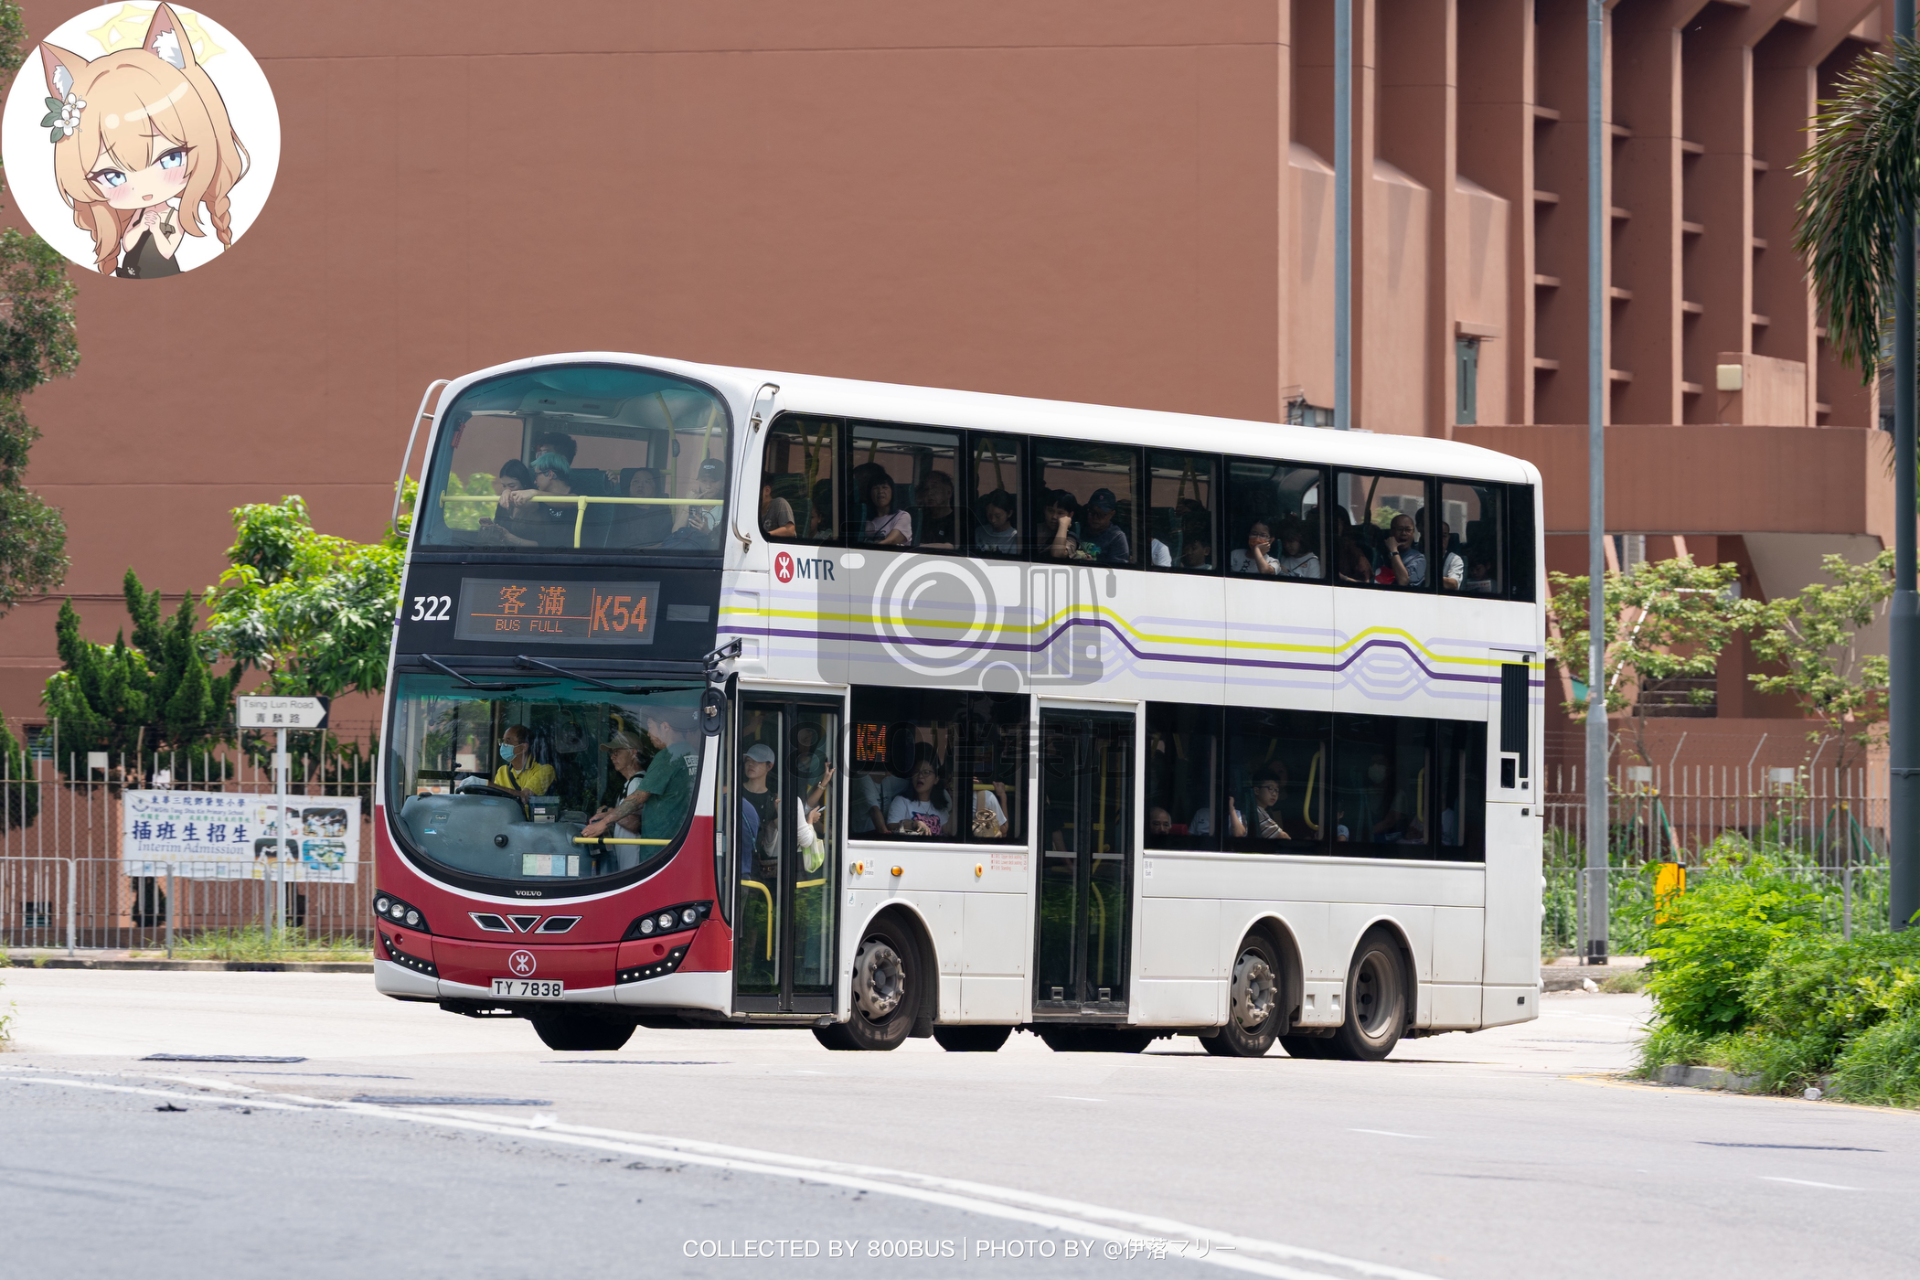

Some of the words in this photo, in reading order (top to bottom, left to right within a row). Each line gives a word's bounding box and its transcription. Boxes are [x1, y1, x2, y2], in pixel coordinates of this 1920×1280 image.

[796, 557, 835, 581] MTR
[410, 595, 452, 621] 322
[498, 585, 567, 616] 客滿
[592, 595, 648, 632] K54
[495, 619, 520, 632] BUS
[529, 620, 563, 633] FULL
[243, 700, 267, 710] Tsing
[270, 700, 287, 708] Lun
[290, 700, 314, 709] Road
[856, 722, 887, 763] K54
[132, 820, 251, 843] 插班生招生
[138, 841, 181, 853] Interim
[184, 843, 245, 855] Admission
[494, 981, 514, 996] TY
[520, 982, 561, 997] 7838
